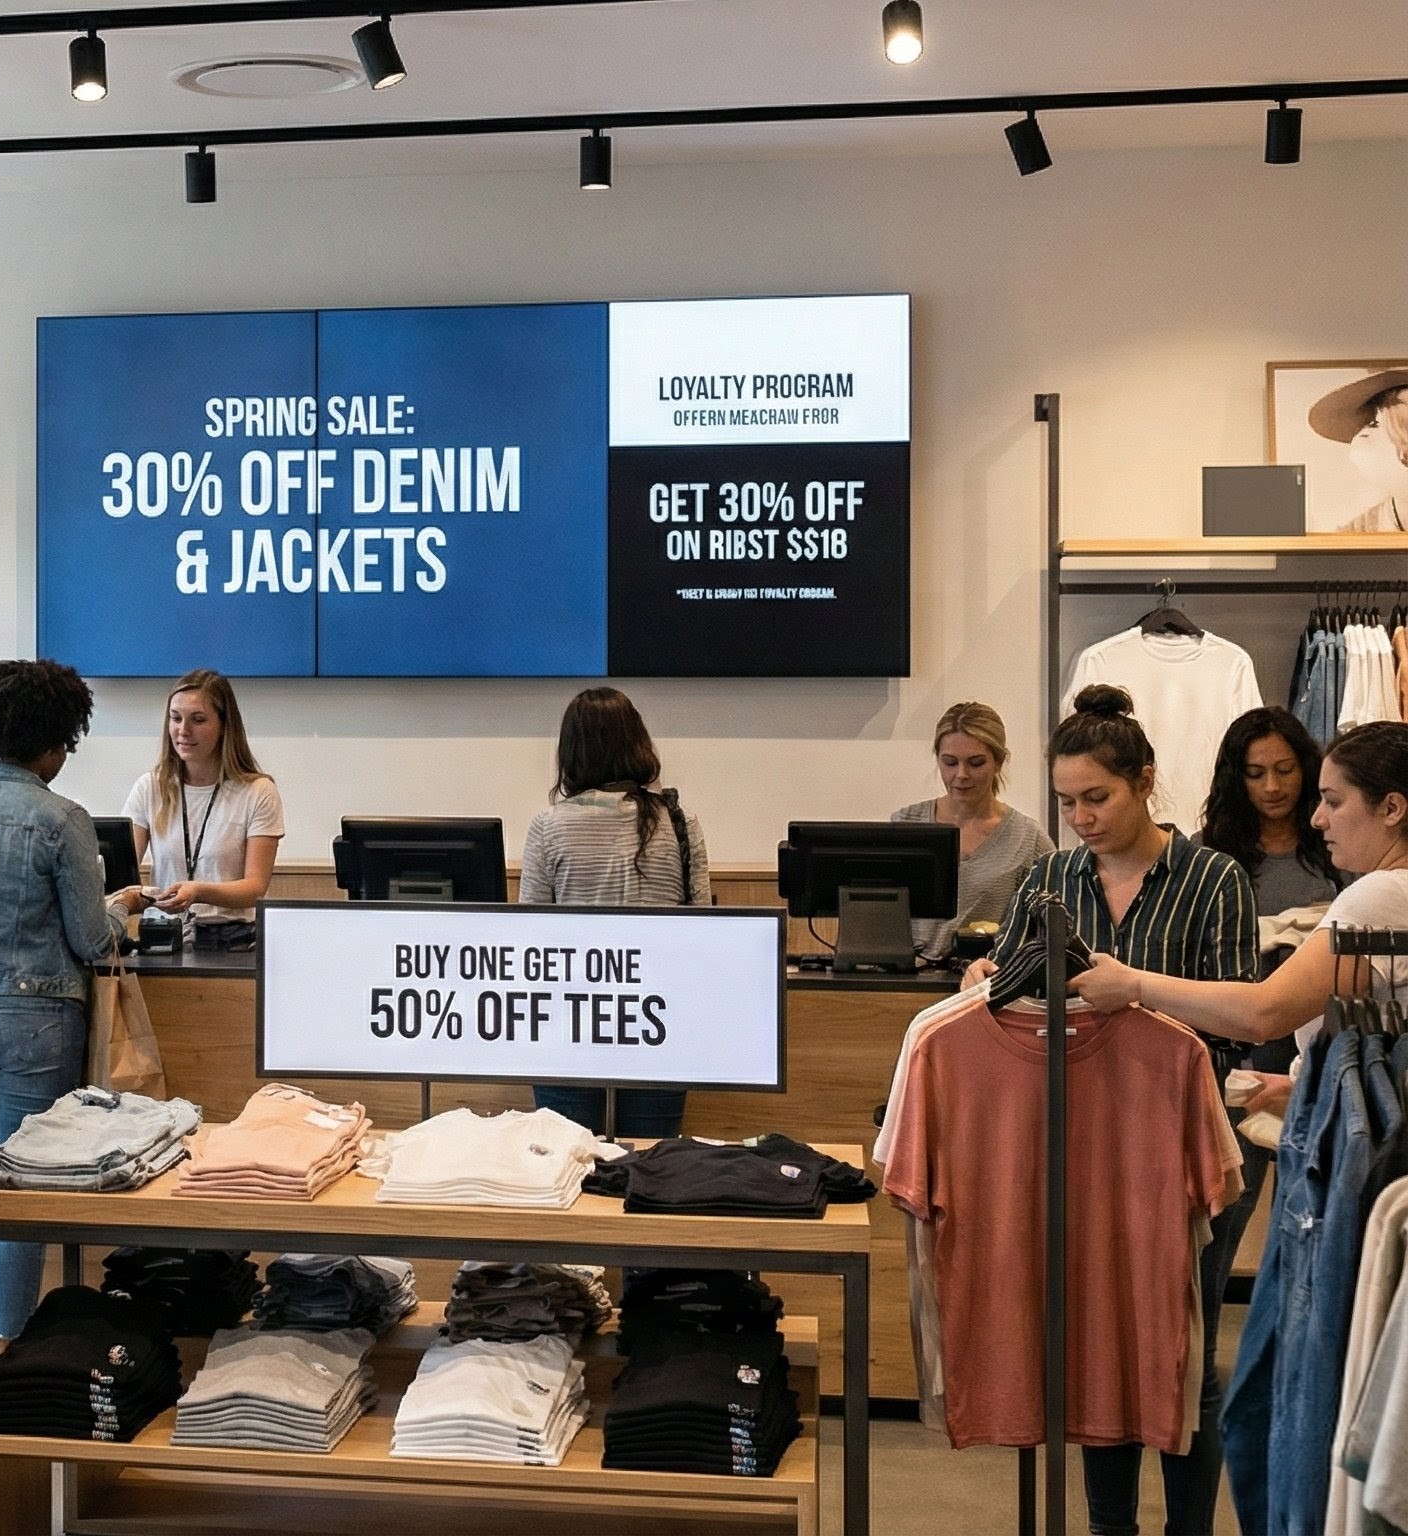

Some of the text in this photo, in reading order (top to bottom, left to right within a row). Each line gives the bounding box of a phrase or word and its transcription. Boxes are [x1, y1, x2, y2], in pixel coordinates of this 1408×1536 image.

[659, 373, 854, 401] LOYALTY PROGRAM
[205, 395, 415, 438] SPRING SALE:
[673, 409, 726, 427] OFFERN
[102, 446, 520, 518] 30% OFF DENIM
[649, 481, 865, 523] GET 30% OFF
[175, 526, 447, 594] & JACKETS
[666, 529, 701, 561] ON
[709, 528, 780, 560] RIBST
[395, 944, 642, 984] BUY ONE GET ONE
[370, 987, 667, 1047] 50% OFF TEES
